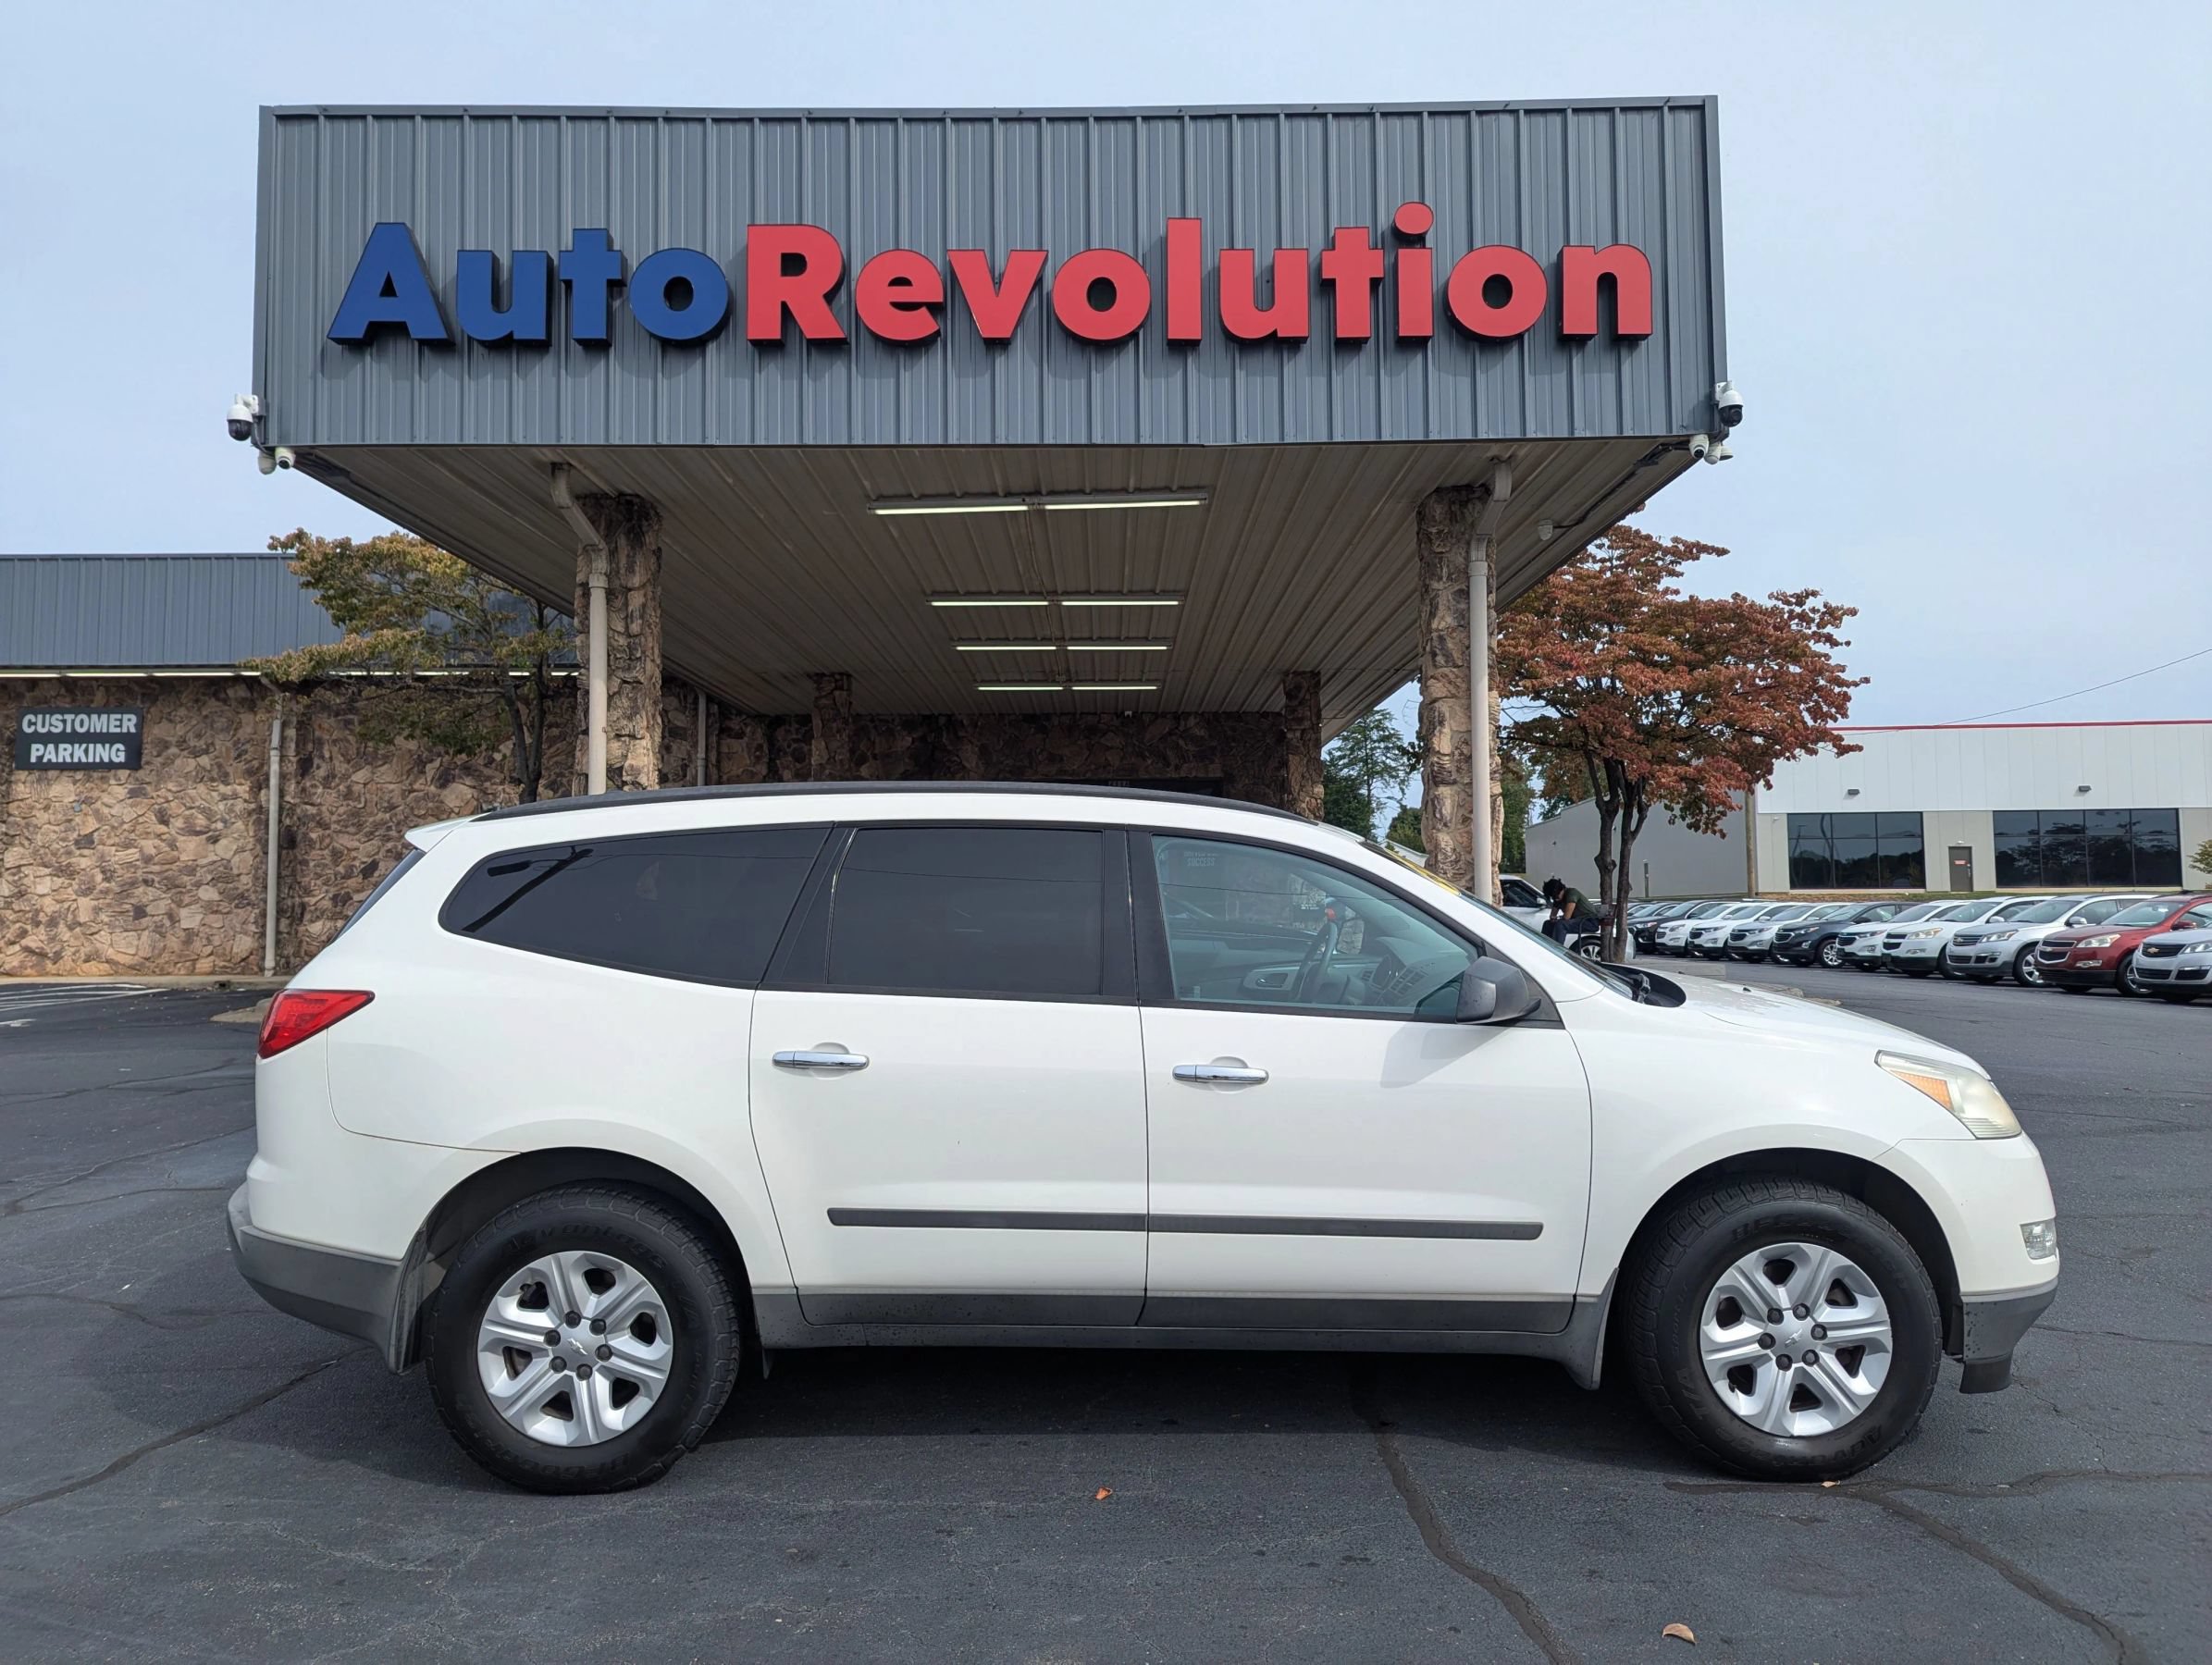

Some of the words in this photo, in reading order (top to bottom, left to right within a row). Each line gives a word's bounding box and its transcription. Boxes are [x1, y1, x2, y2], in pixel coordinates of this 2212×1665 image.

[327, 202, 1653, 344] AutoRevolution
[22, 713, 137, 734] CUSTOMER
[30, 743, 126, 763] PARKING
